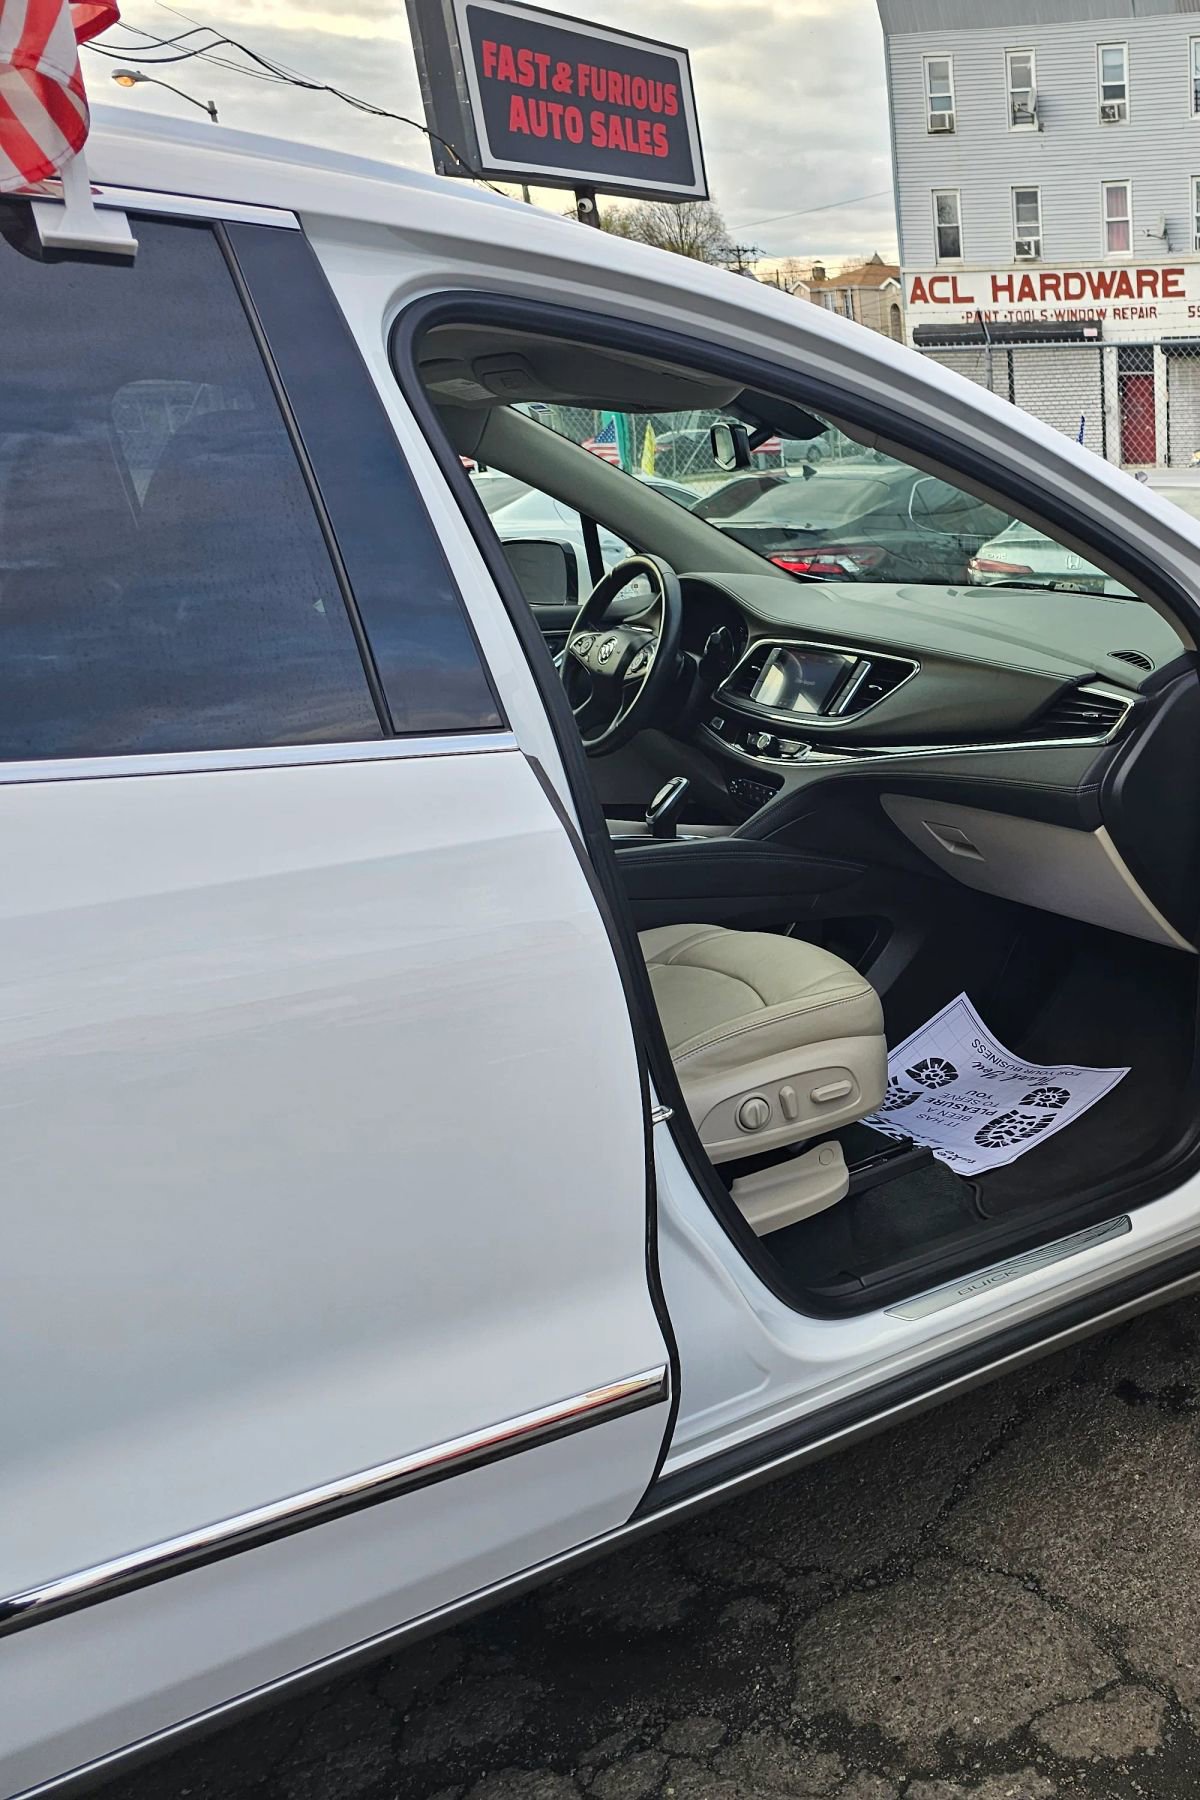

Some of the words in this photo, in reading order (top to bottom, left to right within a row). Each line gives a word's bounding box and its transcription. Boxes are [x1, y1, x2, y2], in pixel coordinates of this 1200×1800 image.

[481, 39, 551, 91] FAST
[577, 63, 679, 117] FURIOUS
[508, 95, 584, 144] AUTO
[590, 111, 669, 158] SALES
[910, 275, 975, 305] ACL
[991, 268, 1186, 303] HARDWARE
[965, 311, 1000, 324] PANT
[1007, 310, 1049, 323] TOOLS
[1054, 308, 1108, 321] WINDOW
[1113, 306, 1158, 320] REPAIR
[971, 1038, 1023, 1073] BUSINESS
[970, 1060, 1006, 1081] You
[1024, 1067, 1055, 1077] YOUR
[938, 1092, 978, 1105] SERVE
[964, 1090, 994, 1100] YOU
[923, 1097, 998, 1117] PLEASURE
[938, 1109, 973, 1122] BEEN
[915, 1113, 939, 1125] HAS
[957, 1269, 1019, 1296] BUICK
